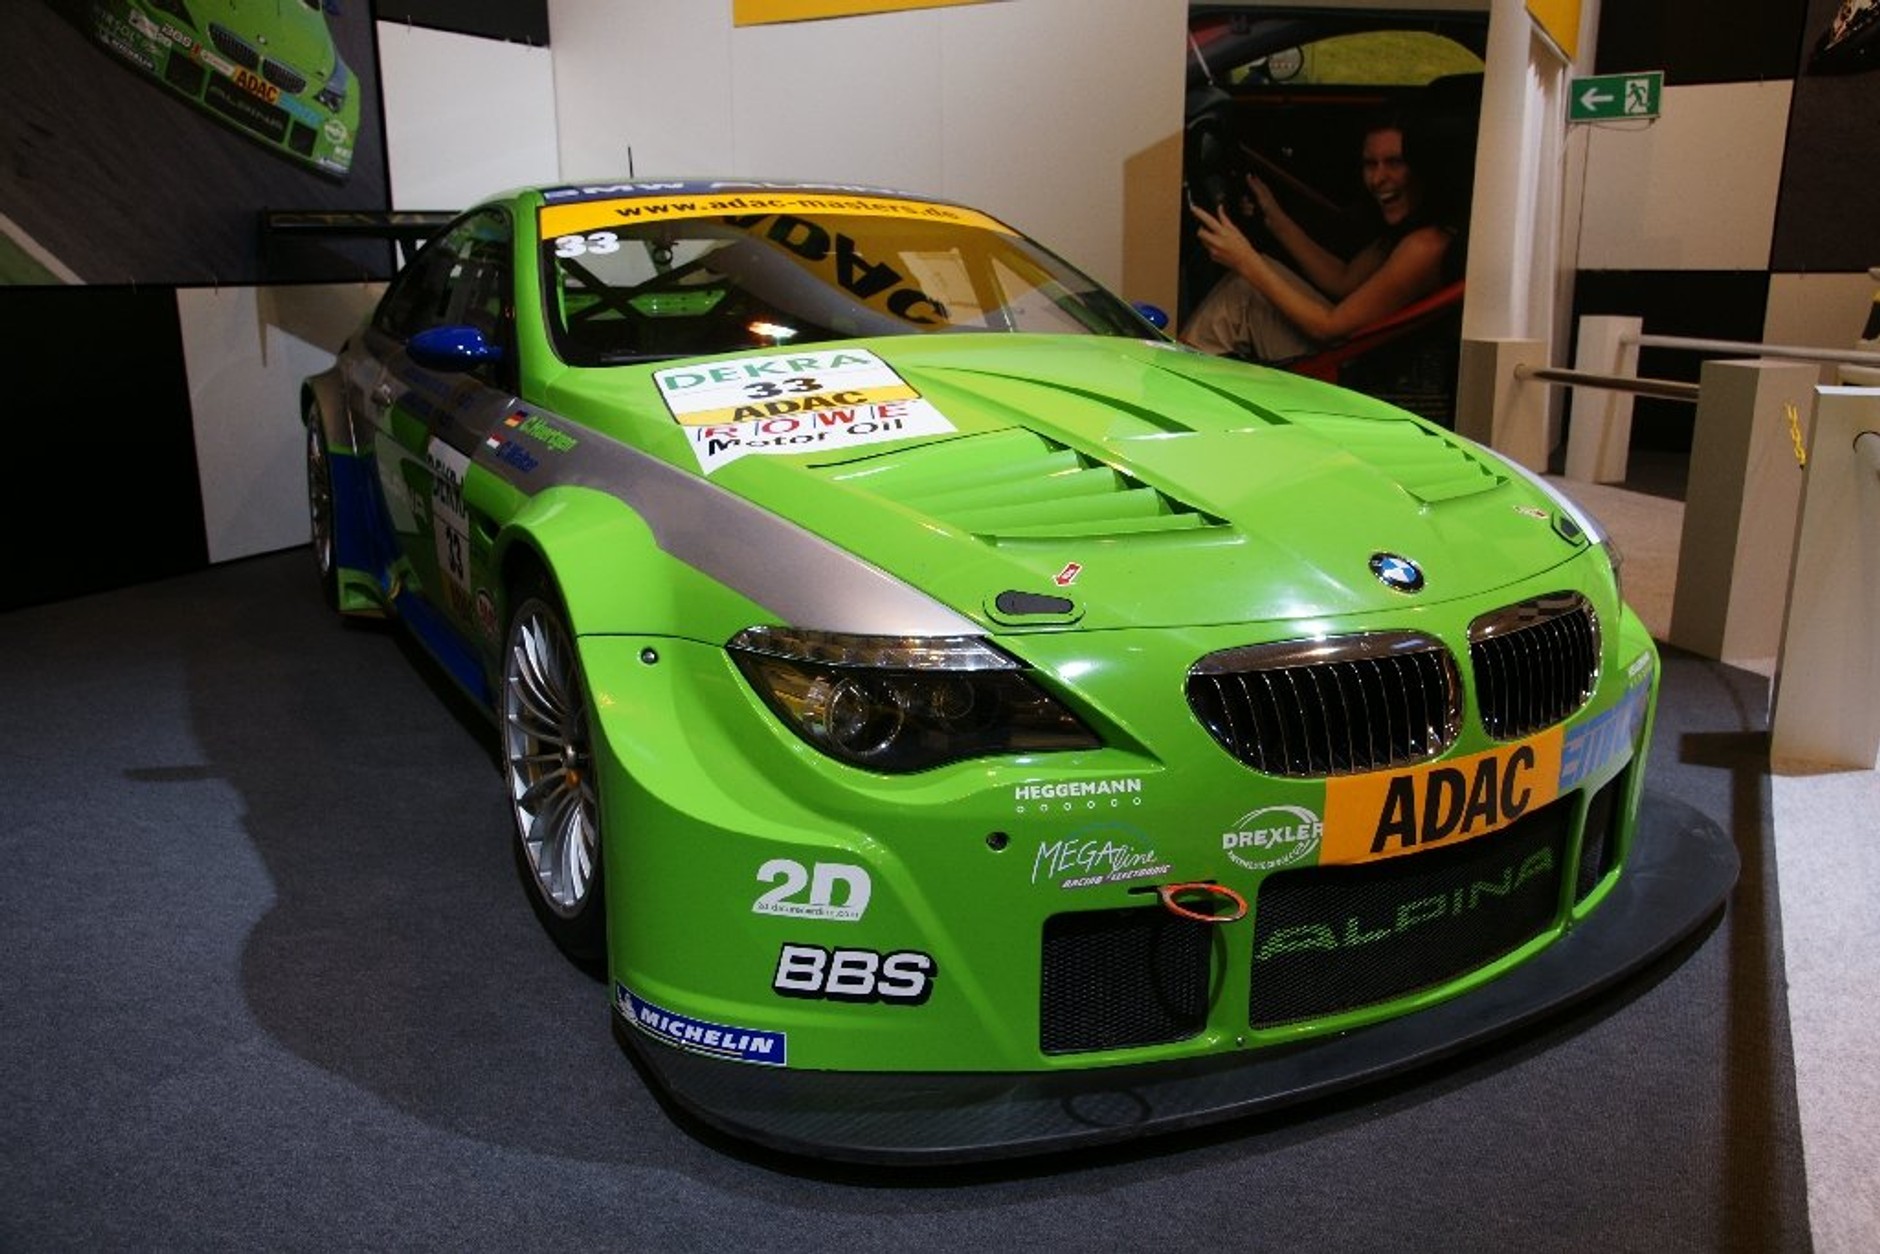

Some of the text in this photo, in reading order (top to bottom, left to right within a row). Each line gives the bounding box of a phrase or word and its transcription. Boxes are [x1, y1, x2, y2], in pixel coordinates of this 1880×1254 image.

[237, 70, 279, 103] ADAC
[615, 197, 959, 220] www.adac-masters.de
[555, 231, 620, 258] 33
[663, 354, 871, 390] DEKRA
[742, 378, 823, 399] 33
[732, 391, 868, 422] ADAC
[708, 419, 903, 457] Motor Oil
[1015, 778, 1142, 800] HEGGEMANN
[1369, 745, 1535, 854] ADAC
[752, 858, 872, 920] 2D
[1256, 844, 1555, 962] ALPINA
[774, 944, 934, 1001] BBS
[640, 1006, 775, 1054] MICHELIN
